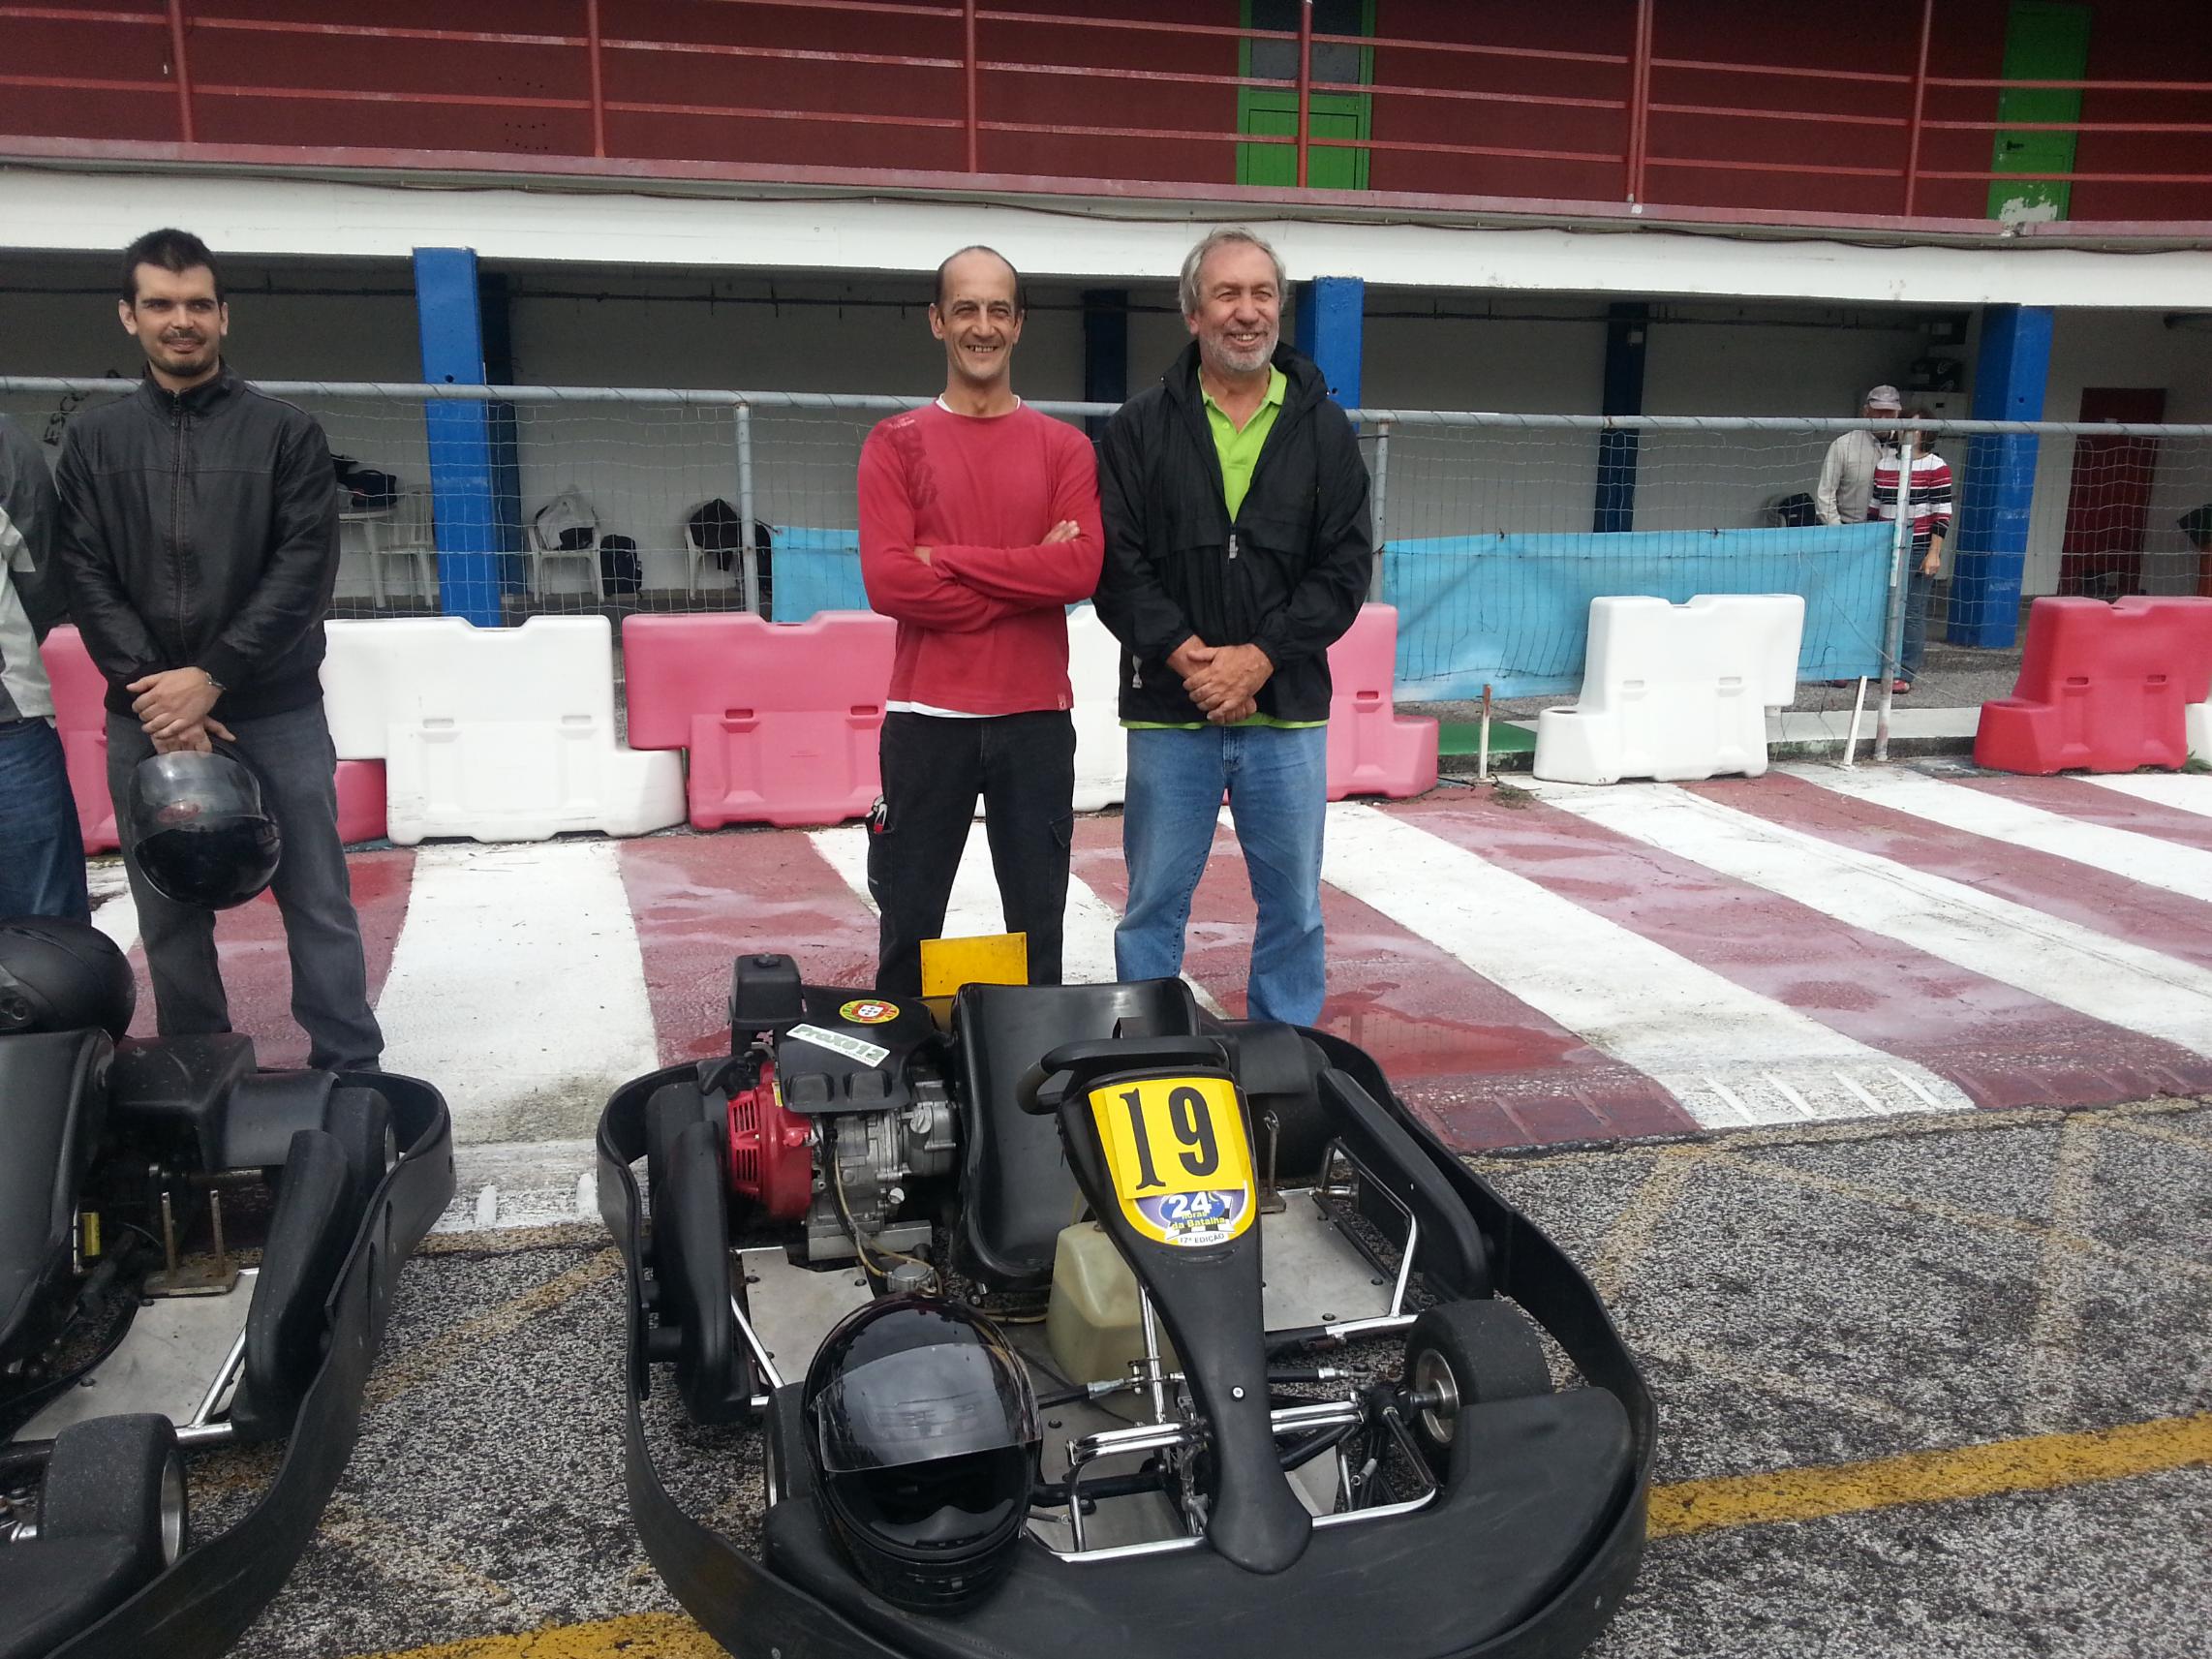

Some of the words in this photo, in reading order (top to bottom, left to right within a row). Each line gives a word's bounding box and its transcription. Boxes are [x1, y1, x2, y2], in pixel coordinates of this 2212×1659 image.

[1120, 1086, 1219, 1190] 19
[1168, 1192, 1213, 1218] 24
[1172, 1220, 1185, 1231] da
[1186, 1216, 1226, 1228] Batalha
[1194, 1233, 1225, 1244] EDIÇÃO
